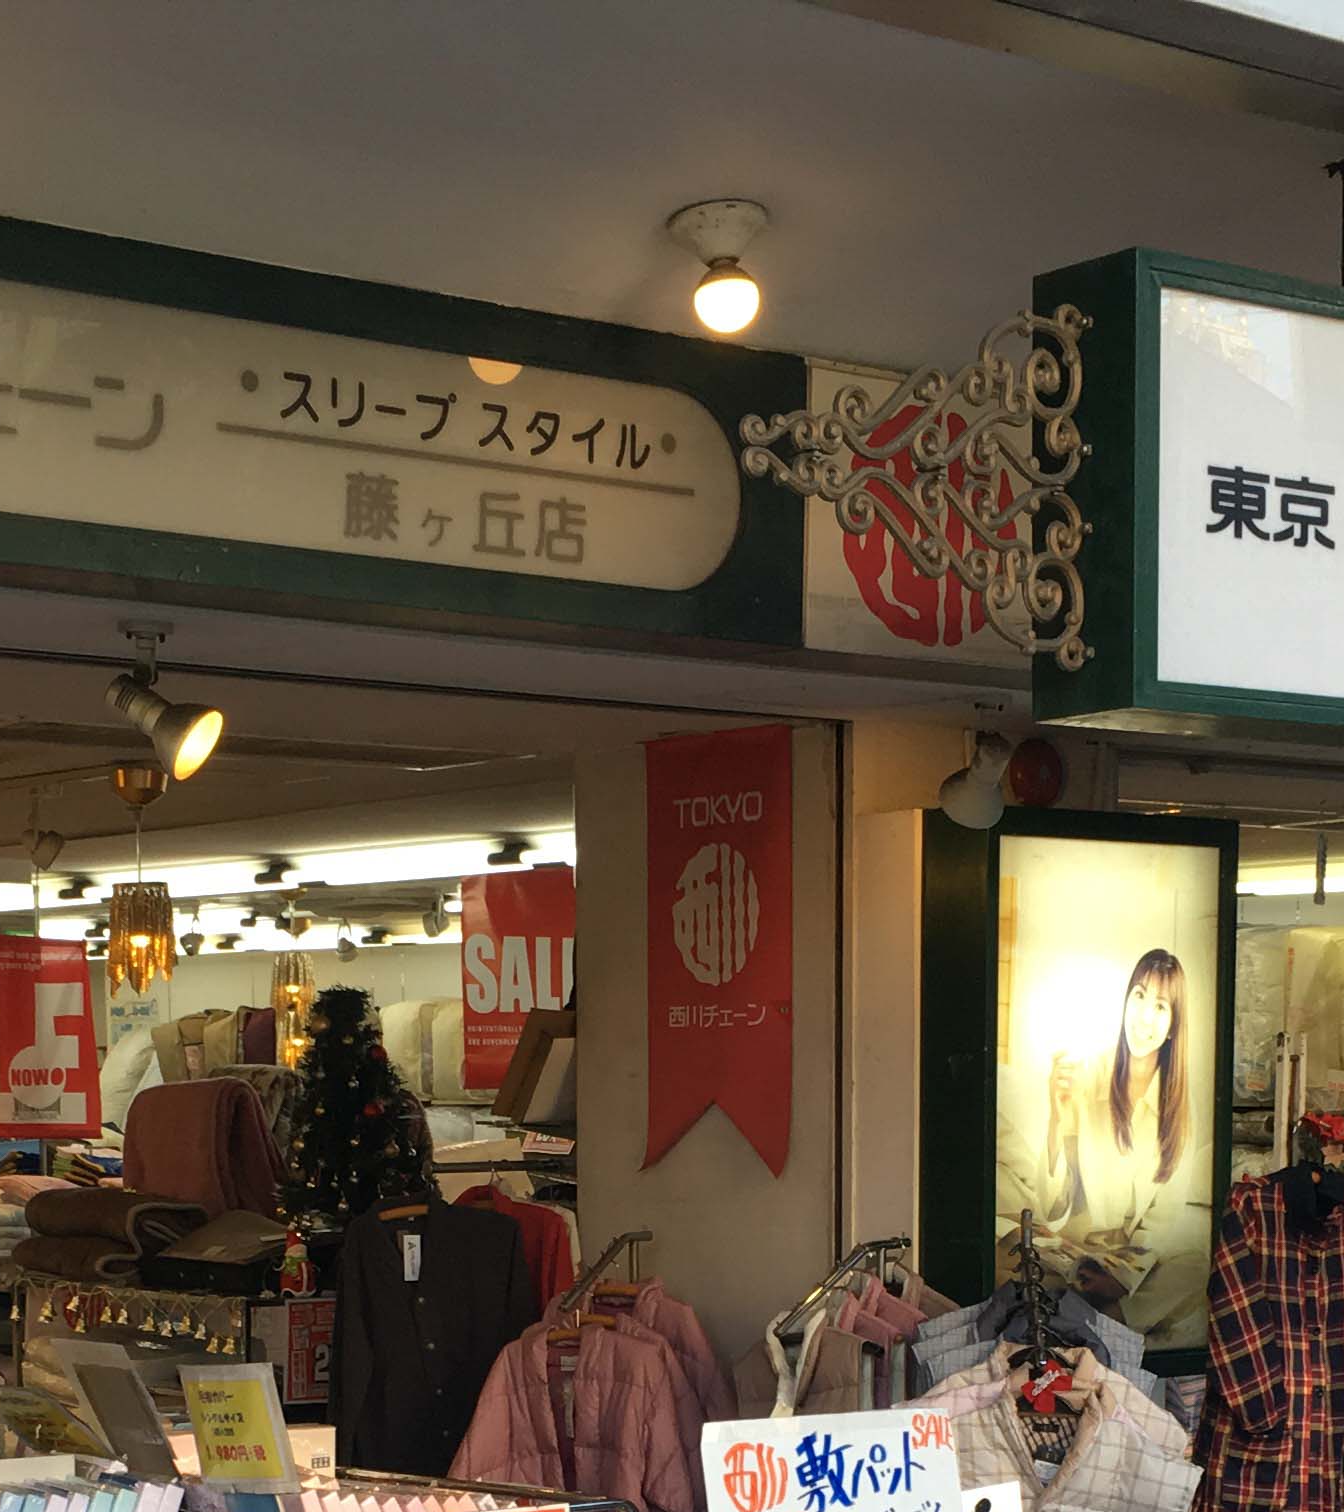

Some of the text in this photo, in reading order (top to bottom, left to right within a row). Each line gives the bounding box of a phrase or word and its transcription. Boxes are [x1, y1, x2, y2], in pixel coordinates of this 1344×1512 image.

[281, 371, 650, 470] スリープ スタイル
[1206, 464, 1336, 550] 東京
[673, 791, 763, 829] TOKYO
[668, 1004, 766, 1028] 西川チェーン
[12, 1068, 50, 1086] NOW
[911, 1413, 954, 1451] SALE
